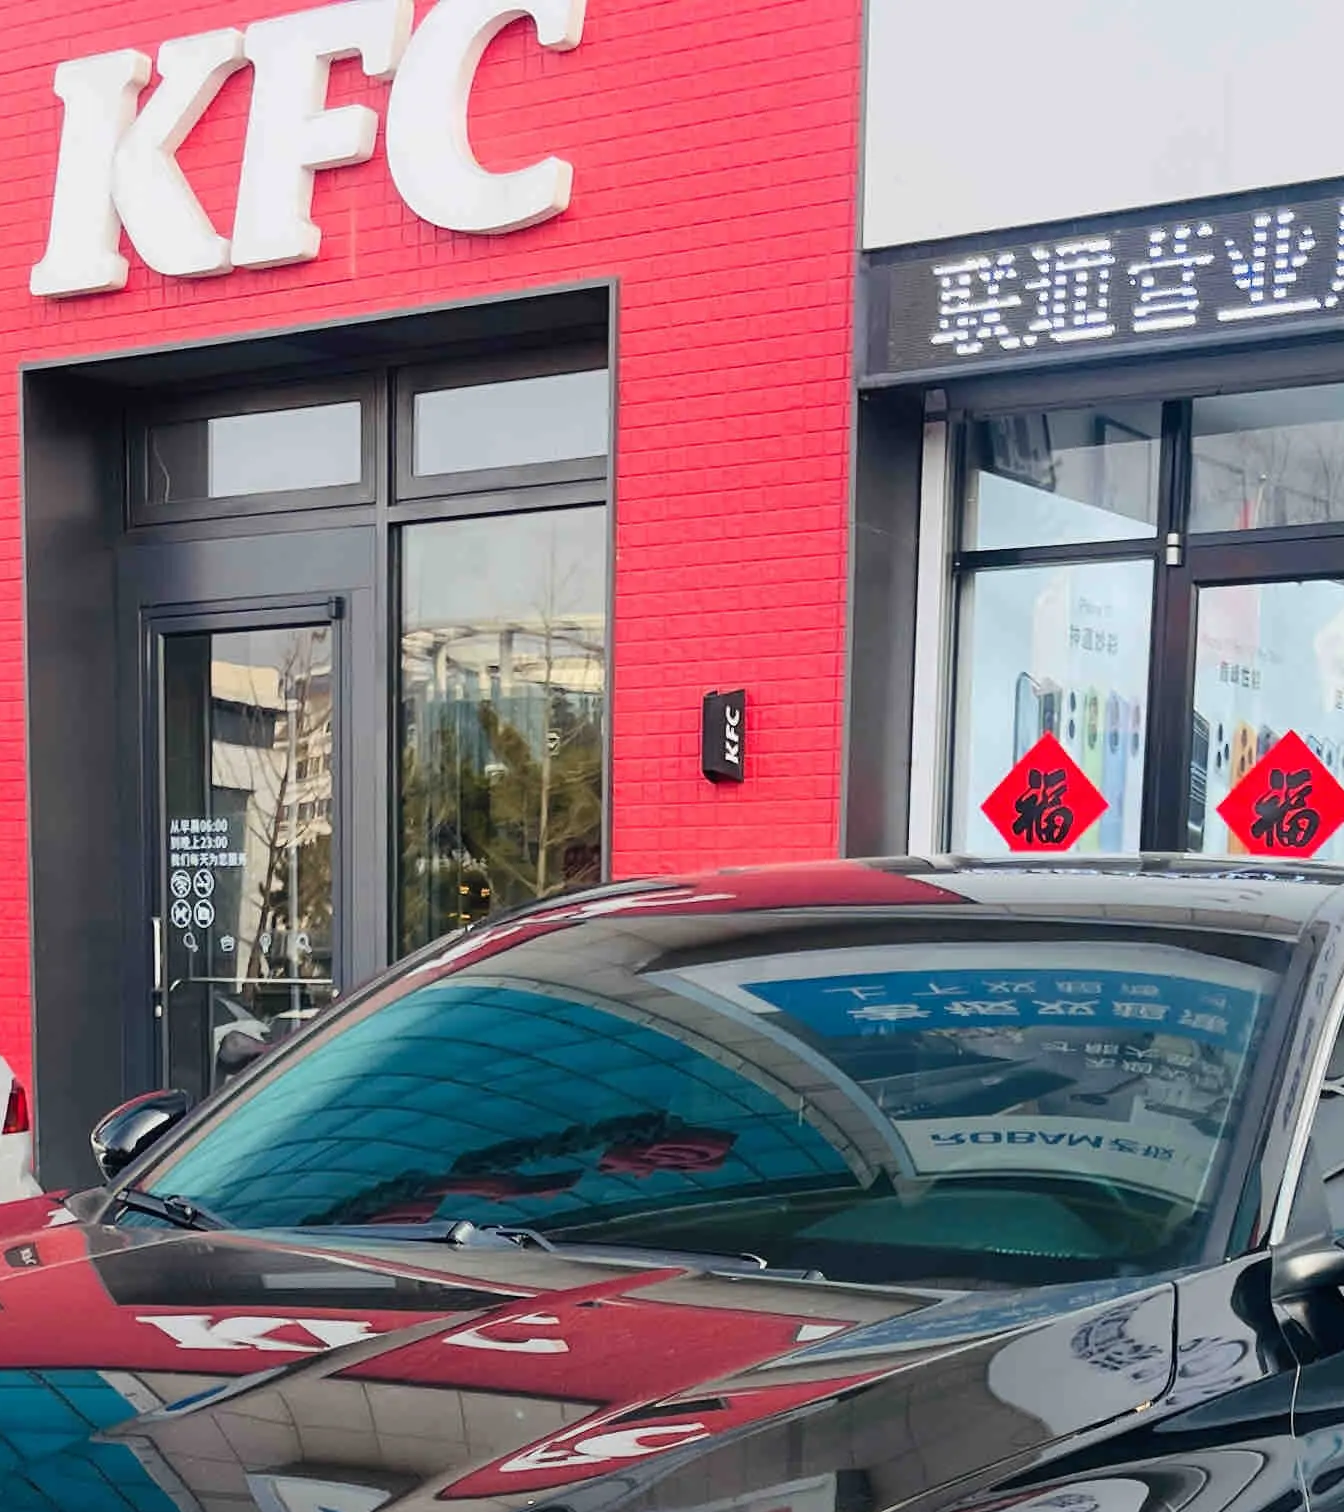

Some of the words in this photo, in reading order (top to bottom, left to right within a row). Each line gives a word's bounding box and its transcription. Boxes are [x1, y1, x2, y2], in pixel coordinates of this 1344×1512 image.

[29, 0, 587, 297] KFC
[725, 704, 741, 764] KFC
[1012, 768, 1074, 844] 福
[1251, 768, 1320, 847] 福
